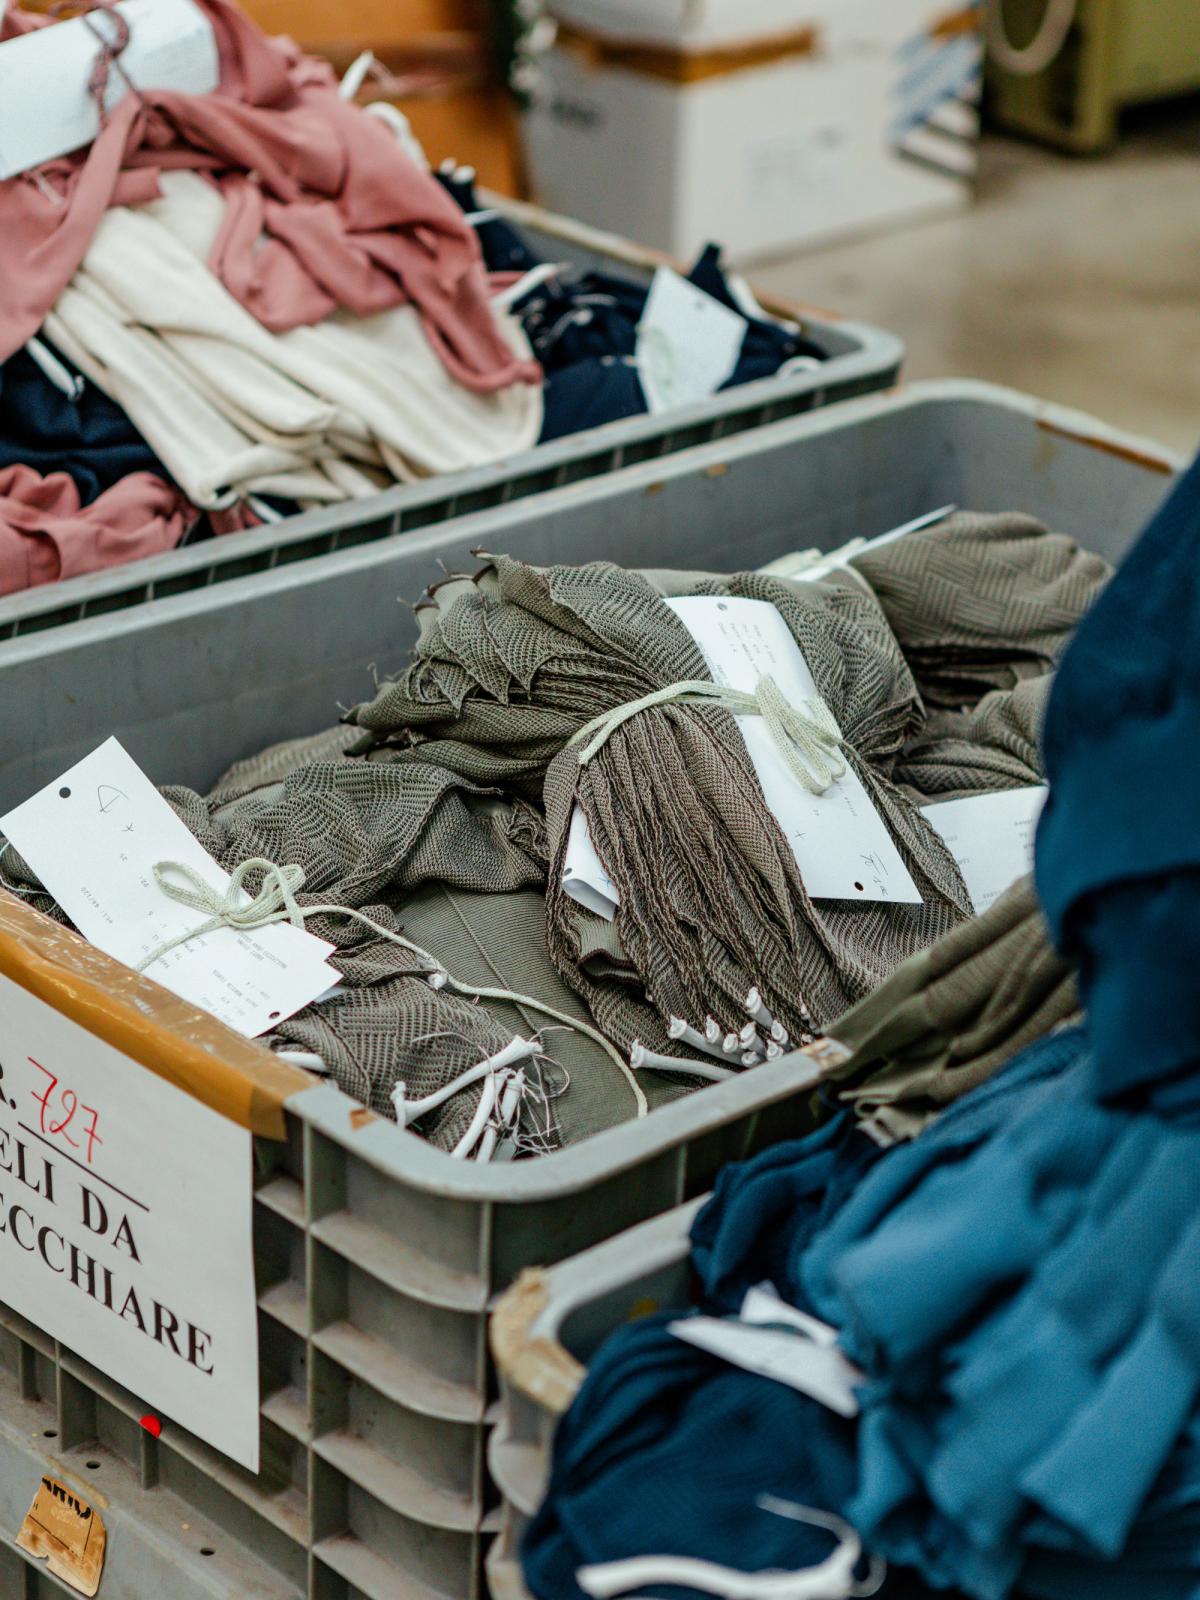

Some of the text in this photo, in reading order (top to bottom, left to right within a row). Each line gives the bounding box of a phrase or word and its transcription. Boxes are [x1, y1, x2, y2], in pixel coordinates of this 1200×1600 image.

[27, 1056, 104, 1164] 727
[79, 1183, 142, 1264] DA
[0, 1192, 215, 1377] CCHIARE
